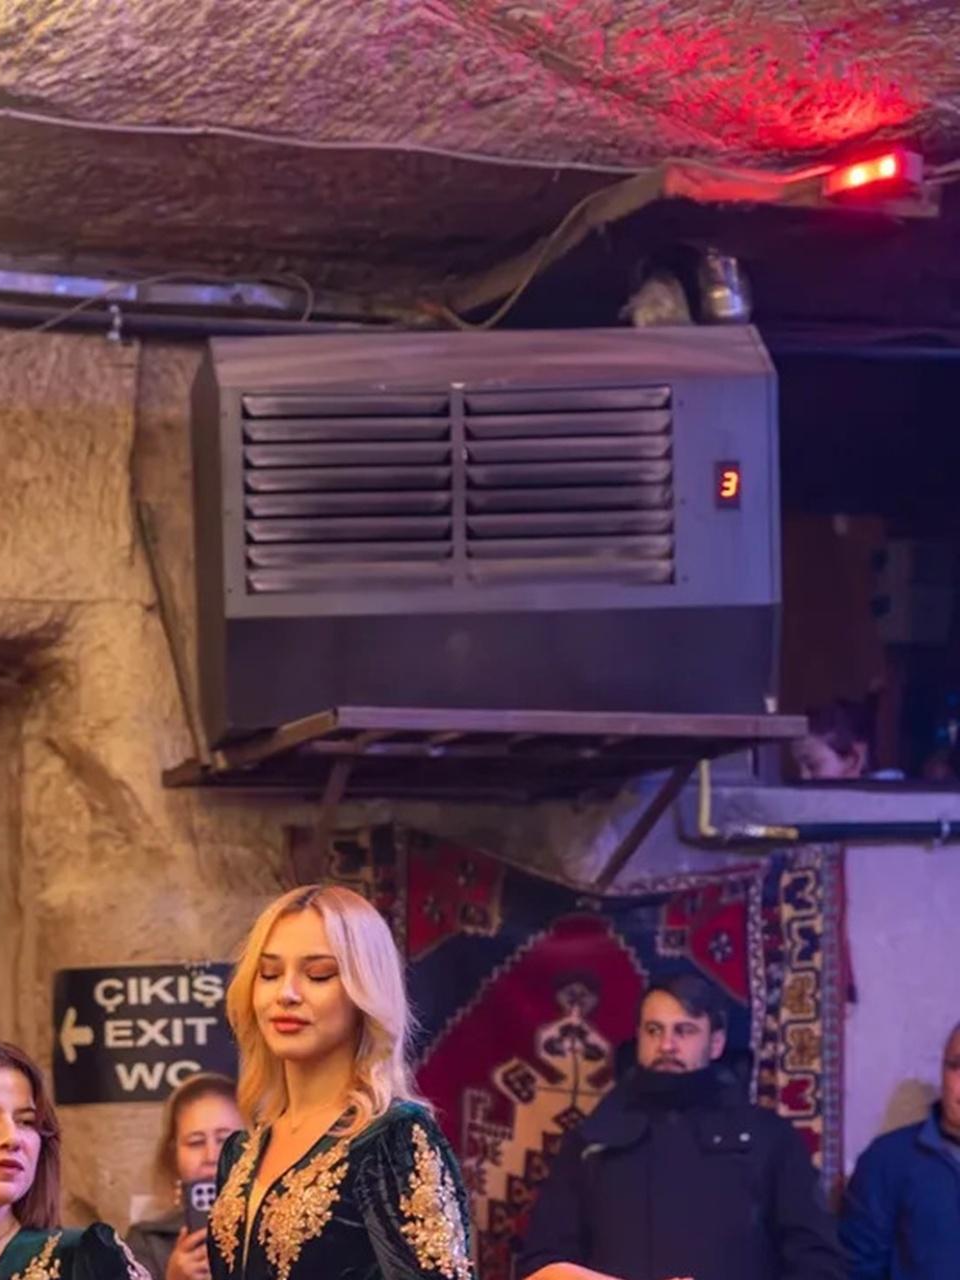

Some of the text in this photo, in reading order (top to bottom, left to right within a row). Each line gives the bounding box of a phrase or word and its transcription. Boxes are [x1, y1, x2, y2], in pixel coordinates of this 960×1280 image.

[721, 471, 738, 497] 3
[94, 975, 224, 1013] ÇIKIŞ
[104, 1017, 218, 1048] EXIT
[115, 1060, 202, 1092] WC
